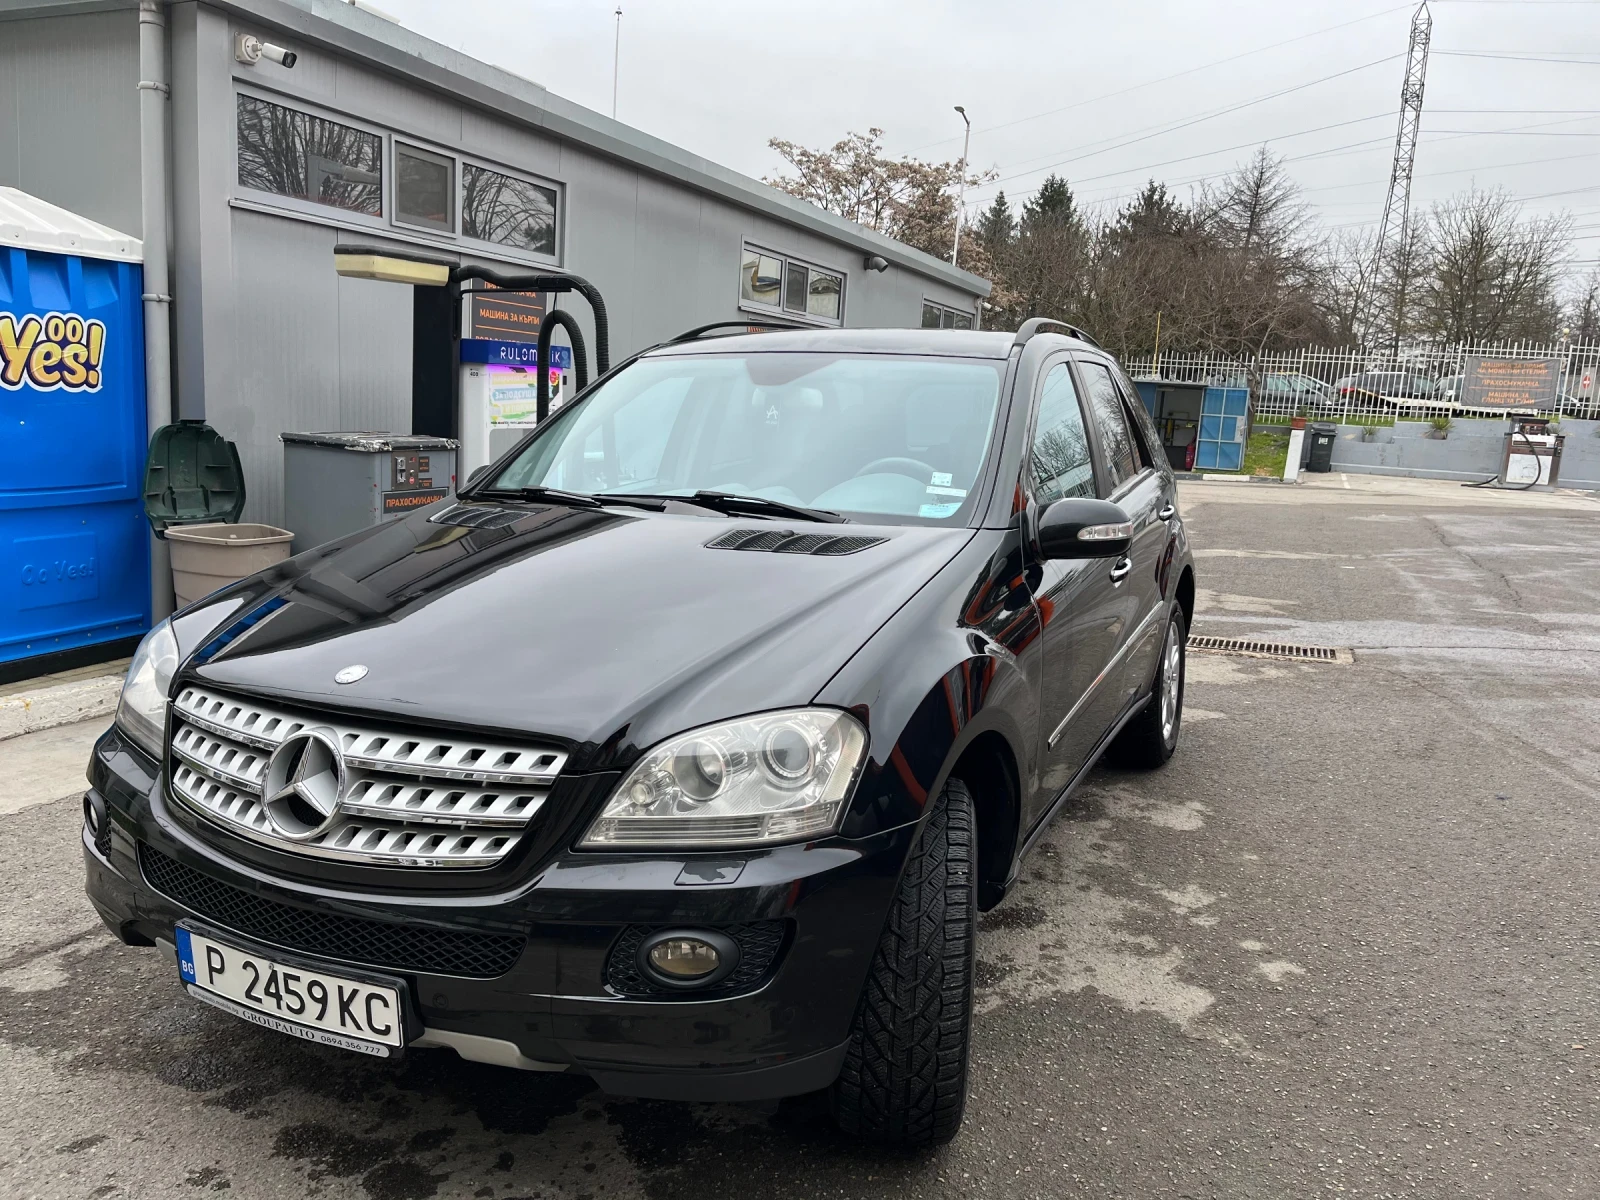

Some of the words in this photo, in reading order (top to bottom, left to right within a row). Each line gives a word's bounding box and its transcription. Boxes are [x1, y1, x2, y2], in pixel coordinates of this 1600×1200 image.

[480, 308, 508, 321] МАШИНА
[510, 313, 519, 321] ЗА
[519, 314, 540, 325] КЪРПИ
[504, 389, 538, 400] ПОДСУША
[182, 959, 194, 975] BG
[206, 944, 226, 985] P
[242, 960, 329, 1022] 2459
[337, 984, 392, 1036] KC
[242, 1010, 315, 1040] GROUPAUTO
[320, 1034, 343, 1046] 0894
[345, 1041, 362, 1050] 356
[364, 1045, 381, 1055] 777
